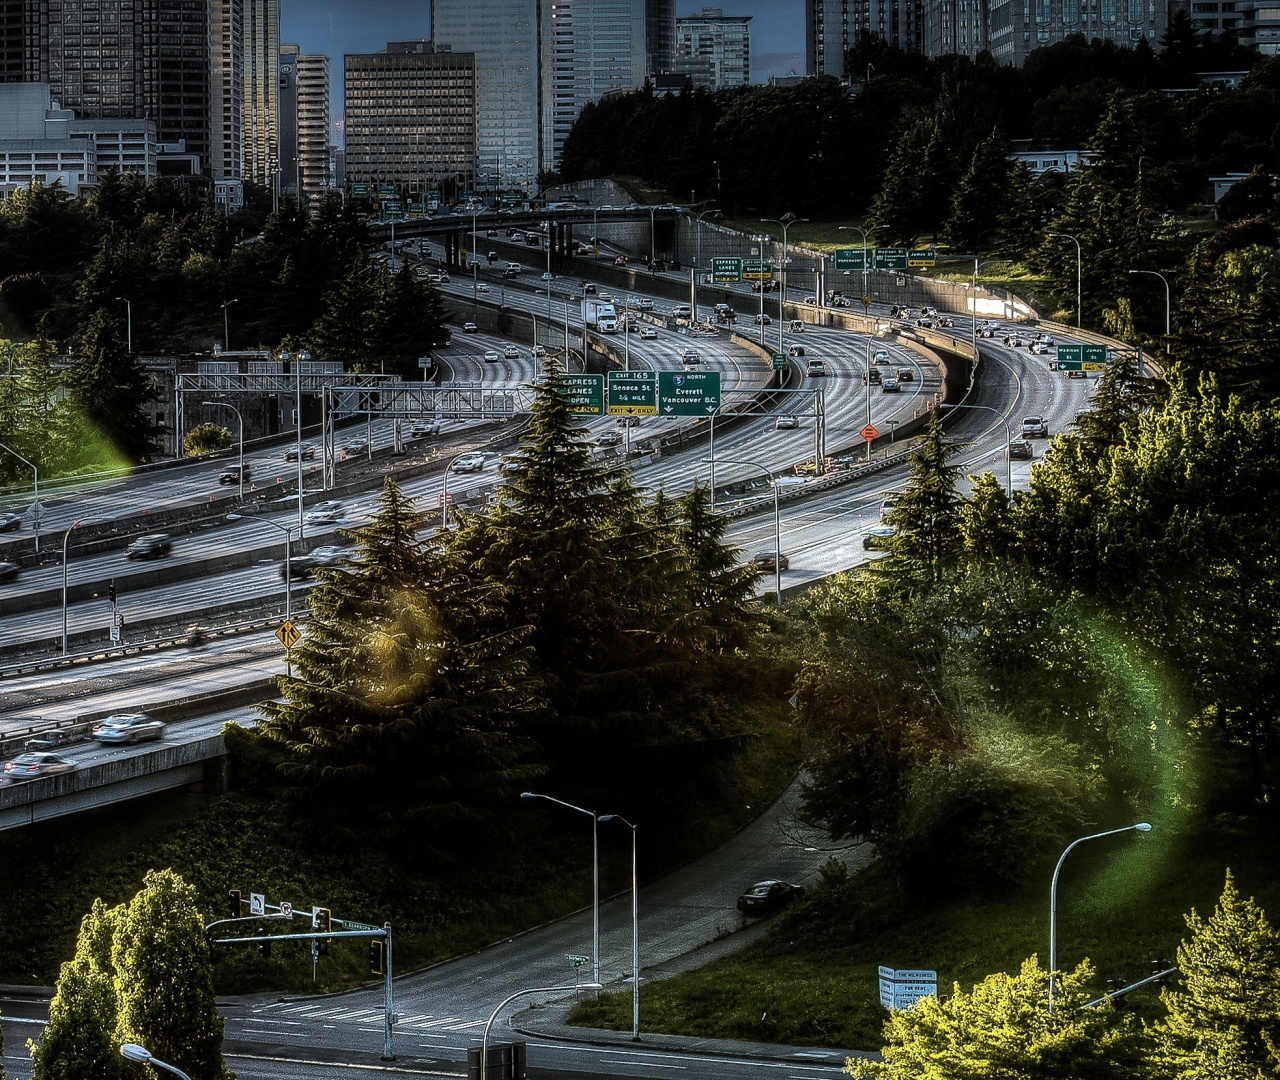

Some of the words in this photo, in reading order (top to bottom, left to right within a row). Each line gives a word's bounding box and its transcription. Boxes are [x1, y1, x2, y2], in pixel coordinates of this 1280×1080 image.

[675, 376, 682, 384] 5
[662, 396, 701, 404] Vancouver
[704, 396, 718, 404] B.C.
